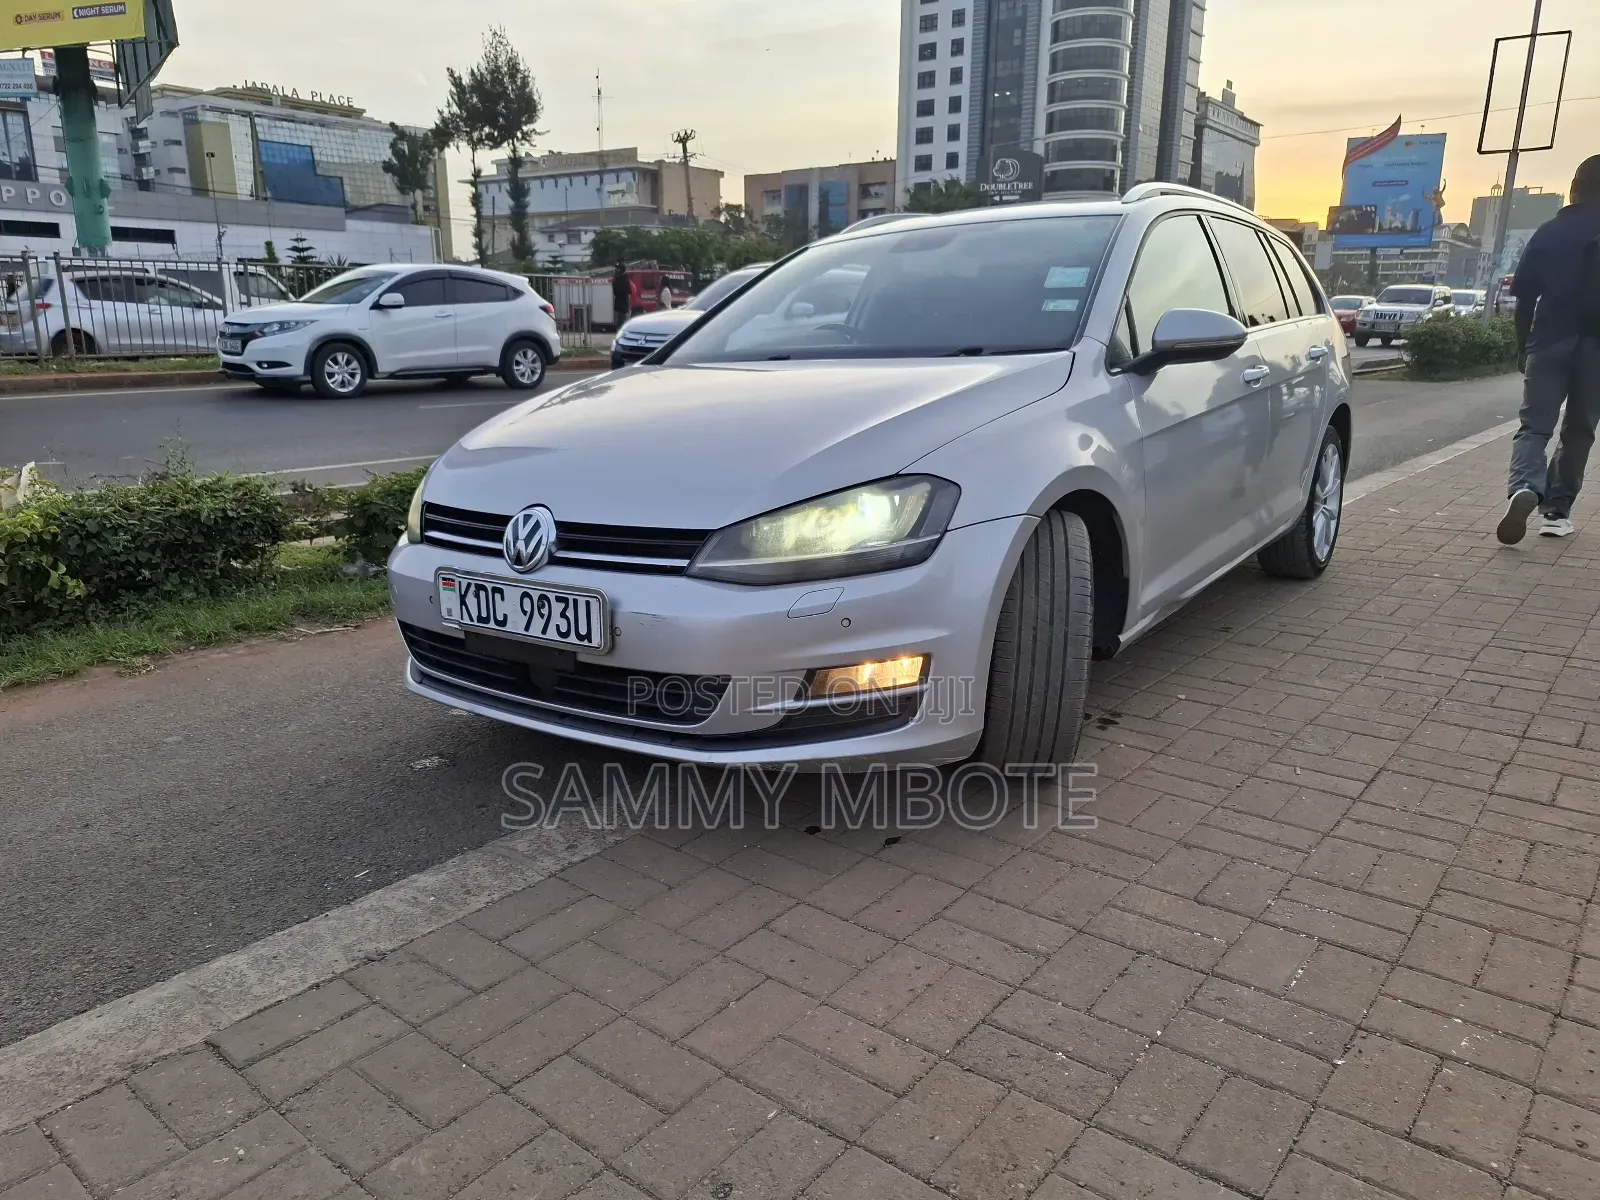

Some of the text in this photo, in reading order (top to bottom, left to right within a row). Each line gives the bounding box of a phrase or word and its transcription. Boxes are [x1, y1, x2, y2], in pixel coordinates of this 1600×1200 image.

[24, 12, 61, 22] DAY SERUM
[79, 4, 125, 17] NIGHT SERUM
[242, 79, 354, 108] JADALA PLACE
[980, 181, 1034, 191] DOUBLETREE
[458, 579, 508, 628] KDC
[519, 590, 593, 644] 993U
